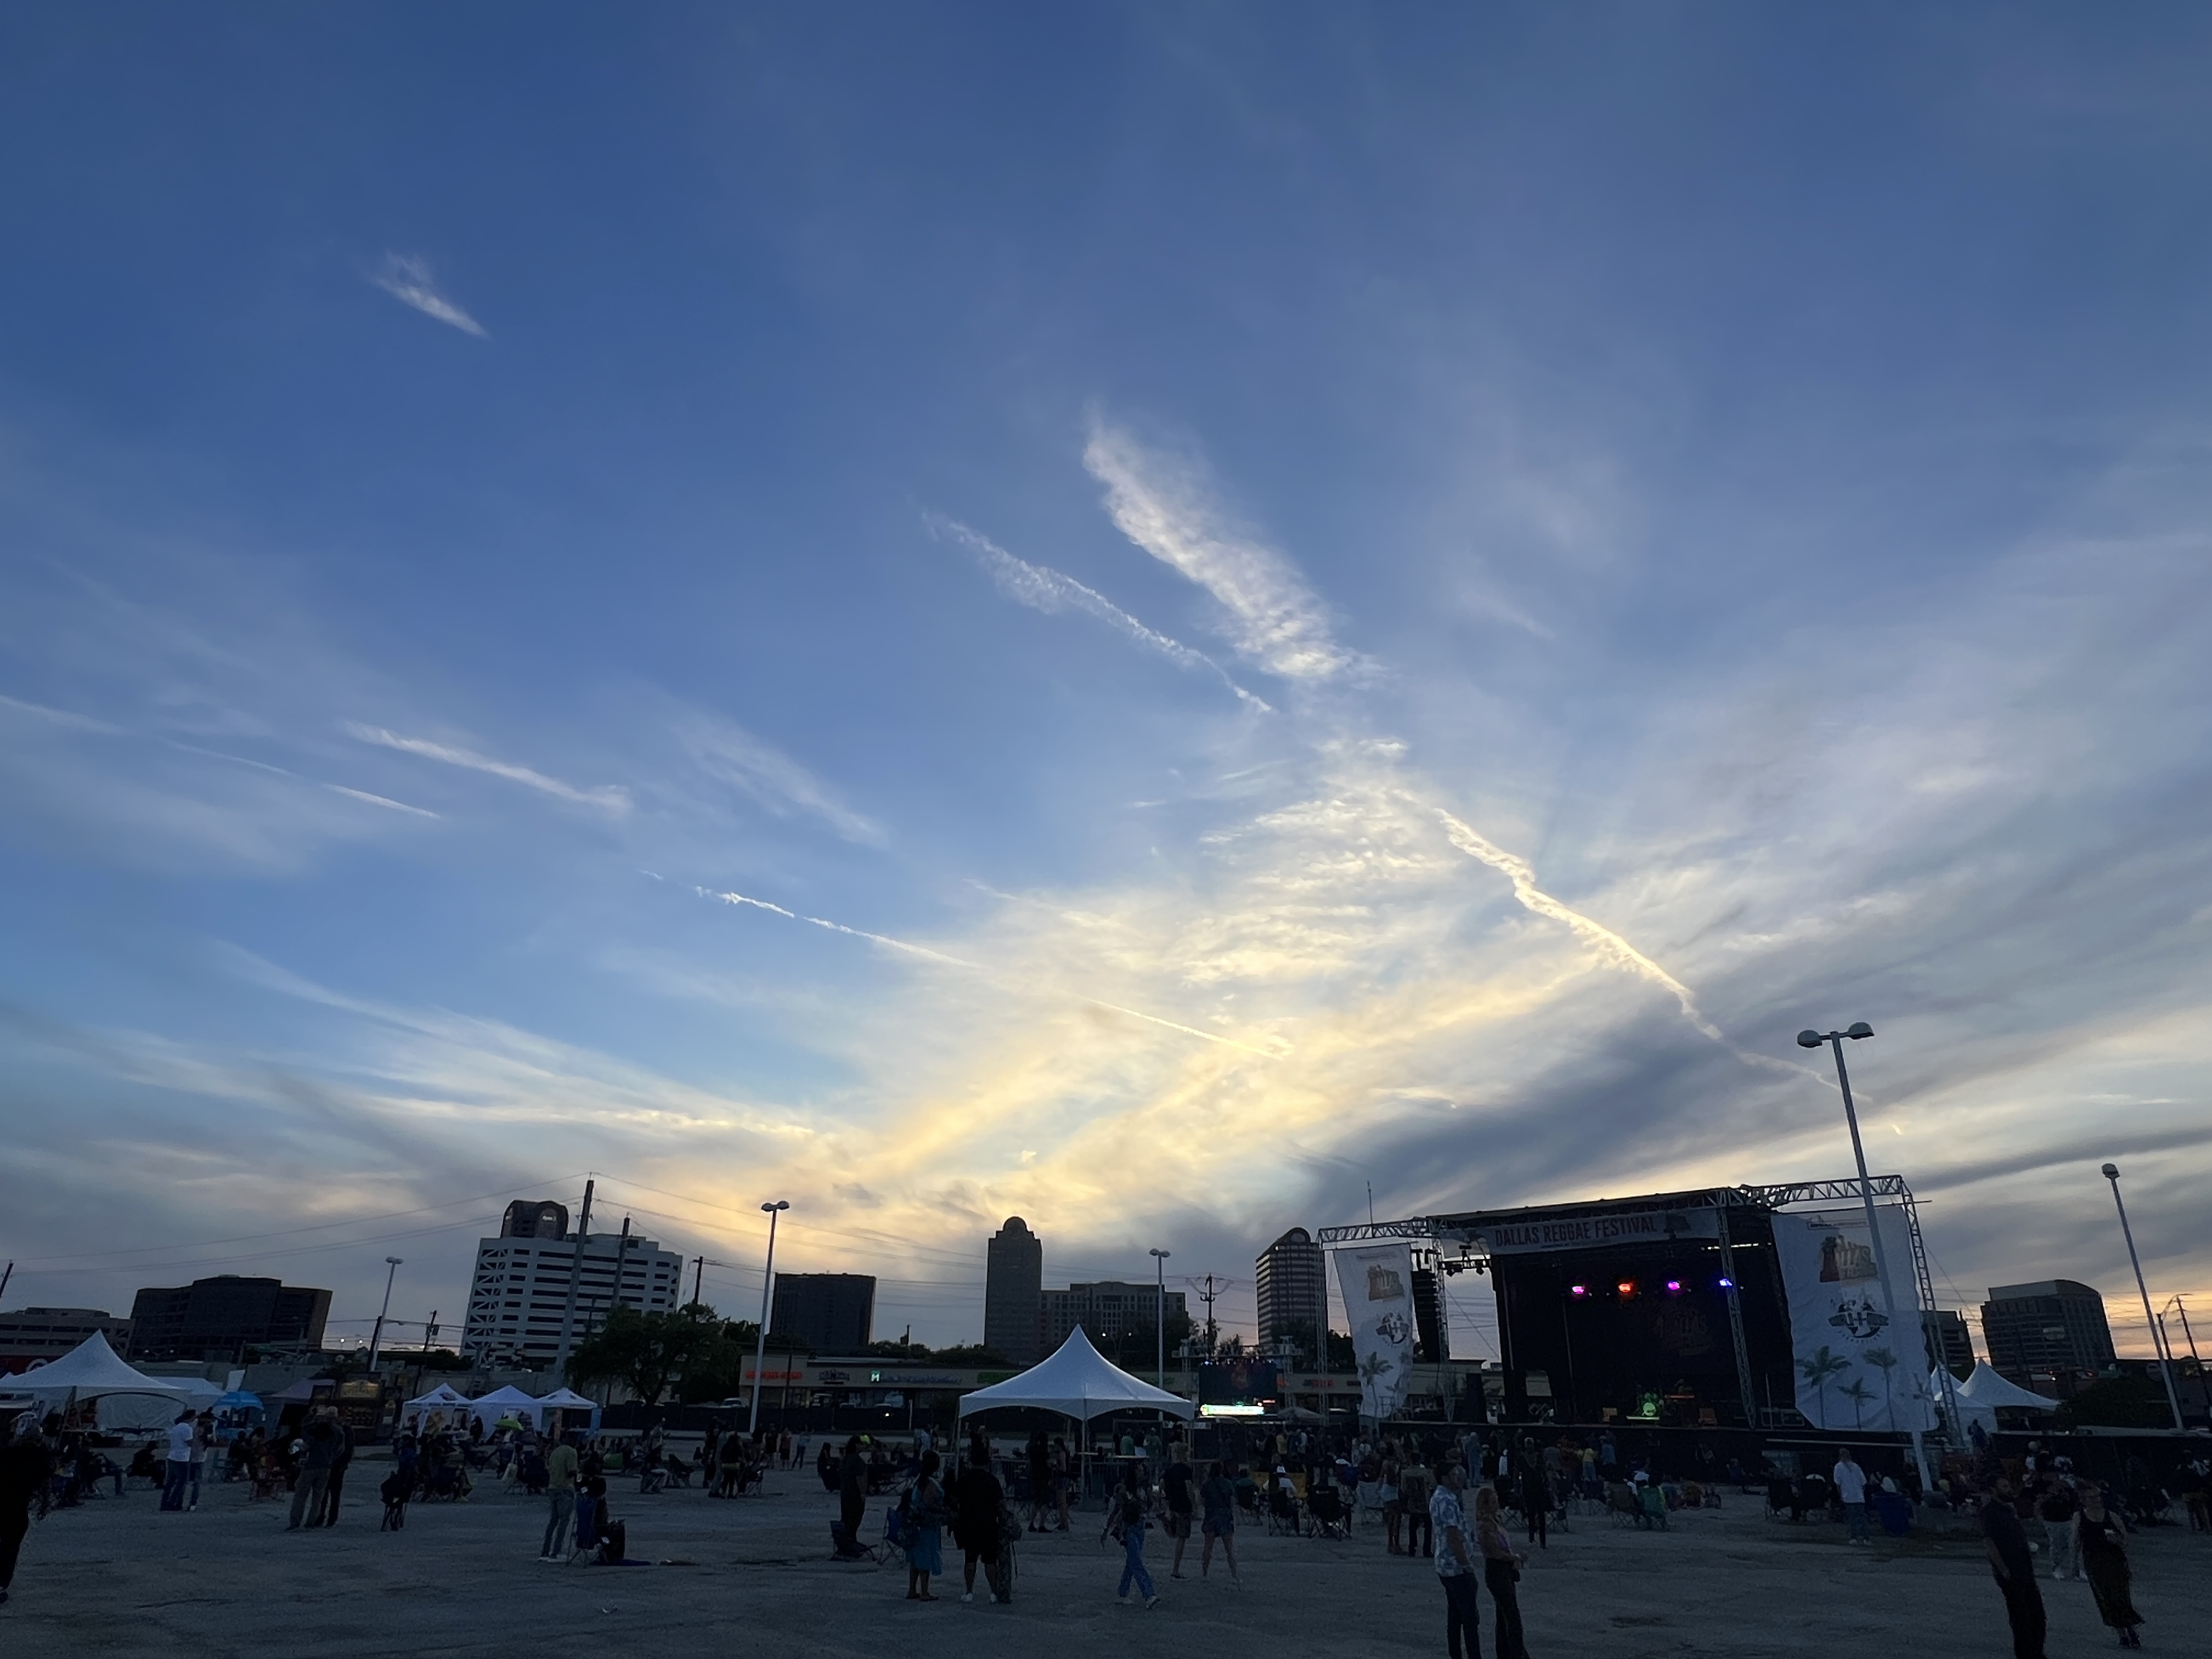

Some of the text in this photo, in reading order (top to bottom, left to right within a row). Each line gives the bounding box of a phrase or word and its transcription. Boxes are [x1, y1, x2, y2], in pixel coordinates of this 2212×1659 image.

[1496, 1227, 1539, 1246] DALLAS
[1544, 1222, 1590, 1243] REGGAE
[1595, 1216, 1657, 1238] FESTIVAL
